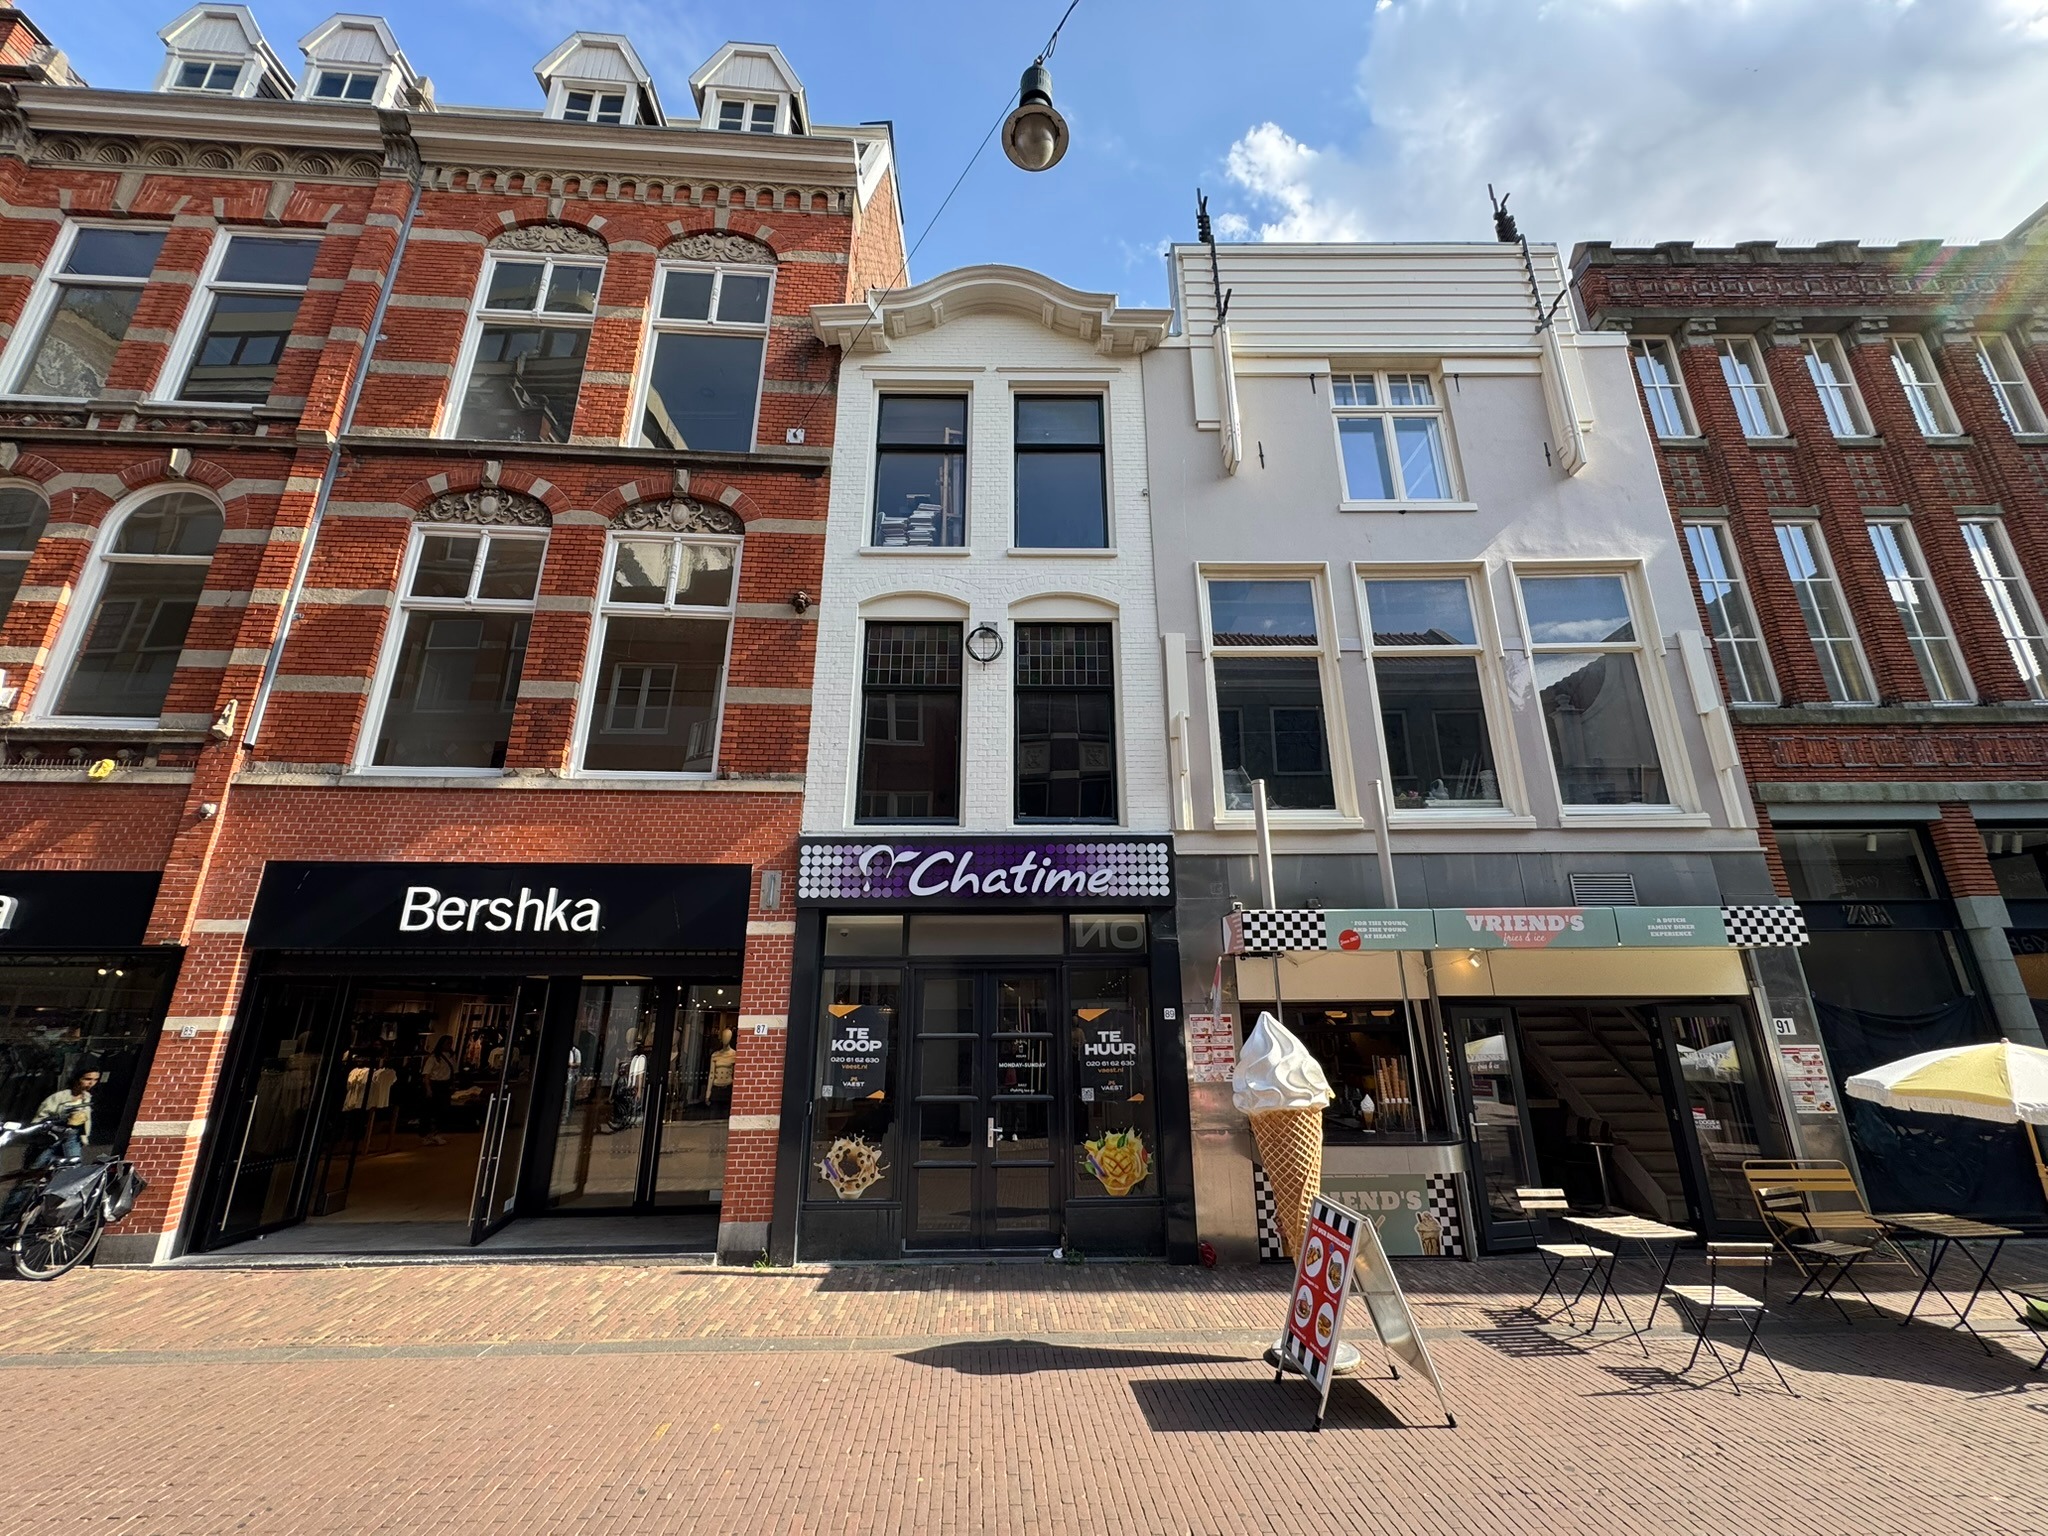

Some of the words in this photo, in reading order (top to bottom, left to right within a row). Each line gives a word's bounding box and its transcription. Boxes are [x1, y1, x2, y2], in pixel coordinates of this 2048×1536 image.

[908, 850, 1104, 896] Chatime
[400, 886, 601, 932] Bershka
[1842, 904, 1896, 926] ZARA
[1465, 915, 1585, 932] VRIEND'S
[1503, 932, 1523, 947] fries
[1524, 931, 1531, 942] &
[1533, 933, 1546, 943] ice
[1165, 1009, 1175, 1019] 89
[184, 1026, 195, 1036] 85
[757, 1024, 766, 1034] 87
[845, 1027, 870, 1039] TE
[1776, 1019, 1791, 1034] 91
[1097, 1030, 1122, 1043] TE
[831, 1039, 883, 1052] KOOP
[1084, 1043, 1137, 1056] HUUR
[1329, 1190, 1423, 1211] IEND'S
